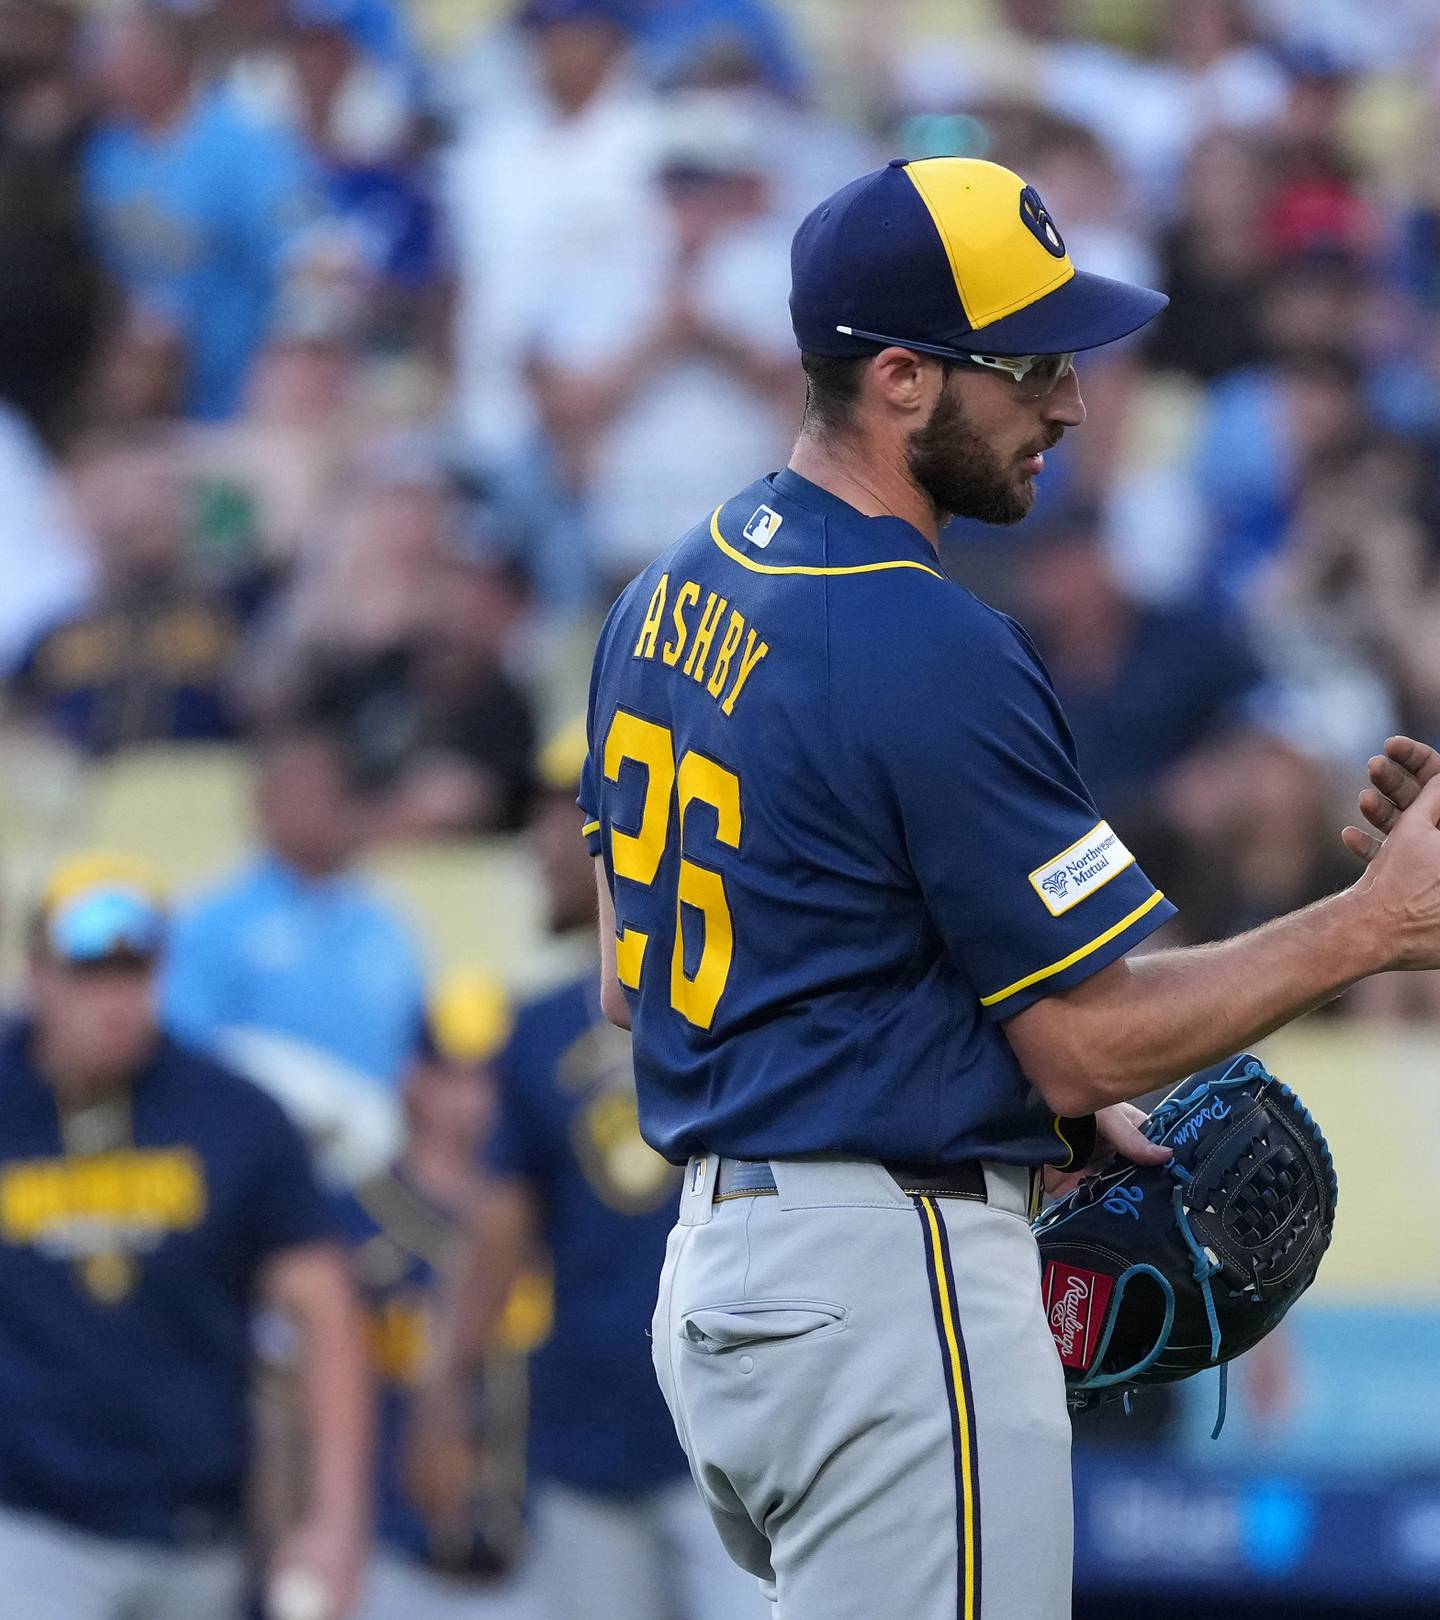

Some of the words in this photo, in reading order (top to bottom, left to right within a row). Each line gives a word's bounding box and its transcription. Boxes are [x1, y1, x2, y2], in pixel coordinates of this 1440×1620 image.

[634, 574, 768, 717] ASHBY
[603, 708, 743, 1031] 26
[1072, 855, 1109, 887] Mutual
[1103, 1186, 1145, 1221] 26
[1053, 1276, 1089, 1357] Rawlings
